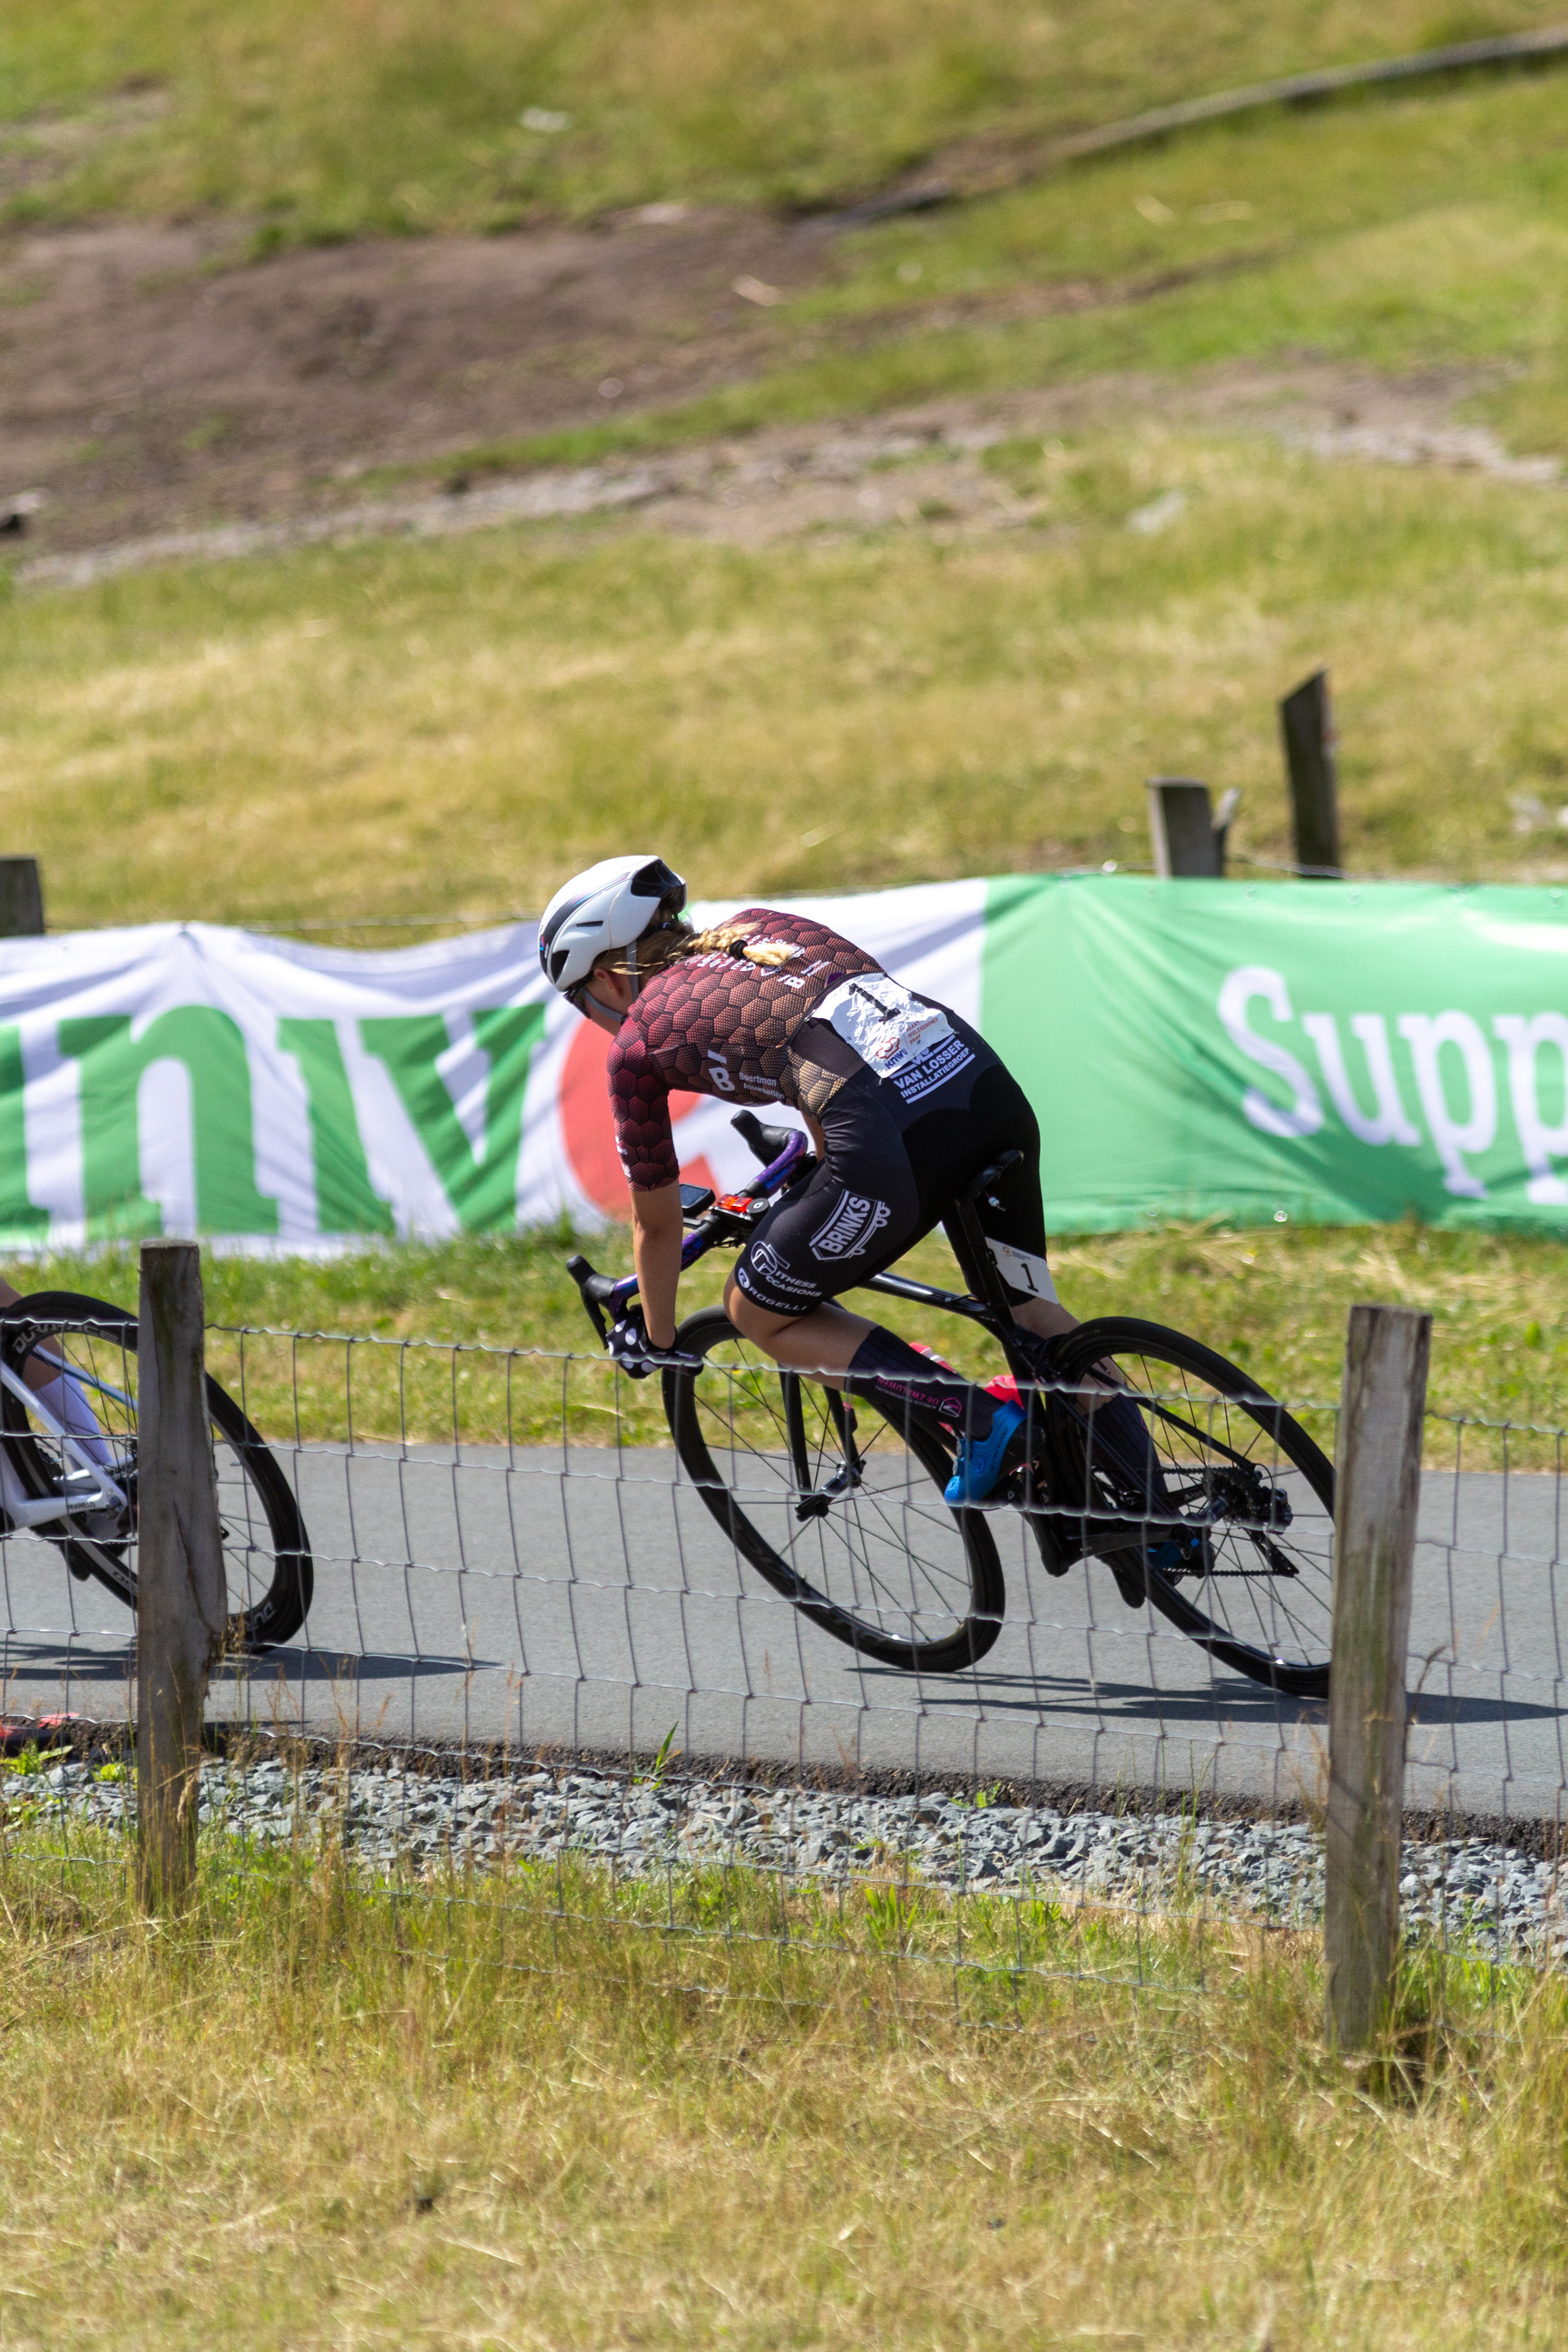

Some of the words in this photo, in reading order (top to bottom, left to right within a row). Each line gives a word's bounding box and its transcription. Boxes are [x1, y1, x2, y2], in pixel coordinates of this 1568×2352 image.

[848, 983, 901, 1024] 1
[739, 1072, 778, 1087] Baartman
[893, 1068, 924, 1090] VAN
[922, 1039, 965, 1077] LOSSER
[899, 1046, 971, 1099] INSTALLATIEGROEP
[818, 1196, 871, 1254] BRINKS
[749, 1286, 808, 1311] ROGELLI
[1021, 1262, 1039, 1294] 1
